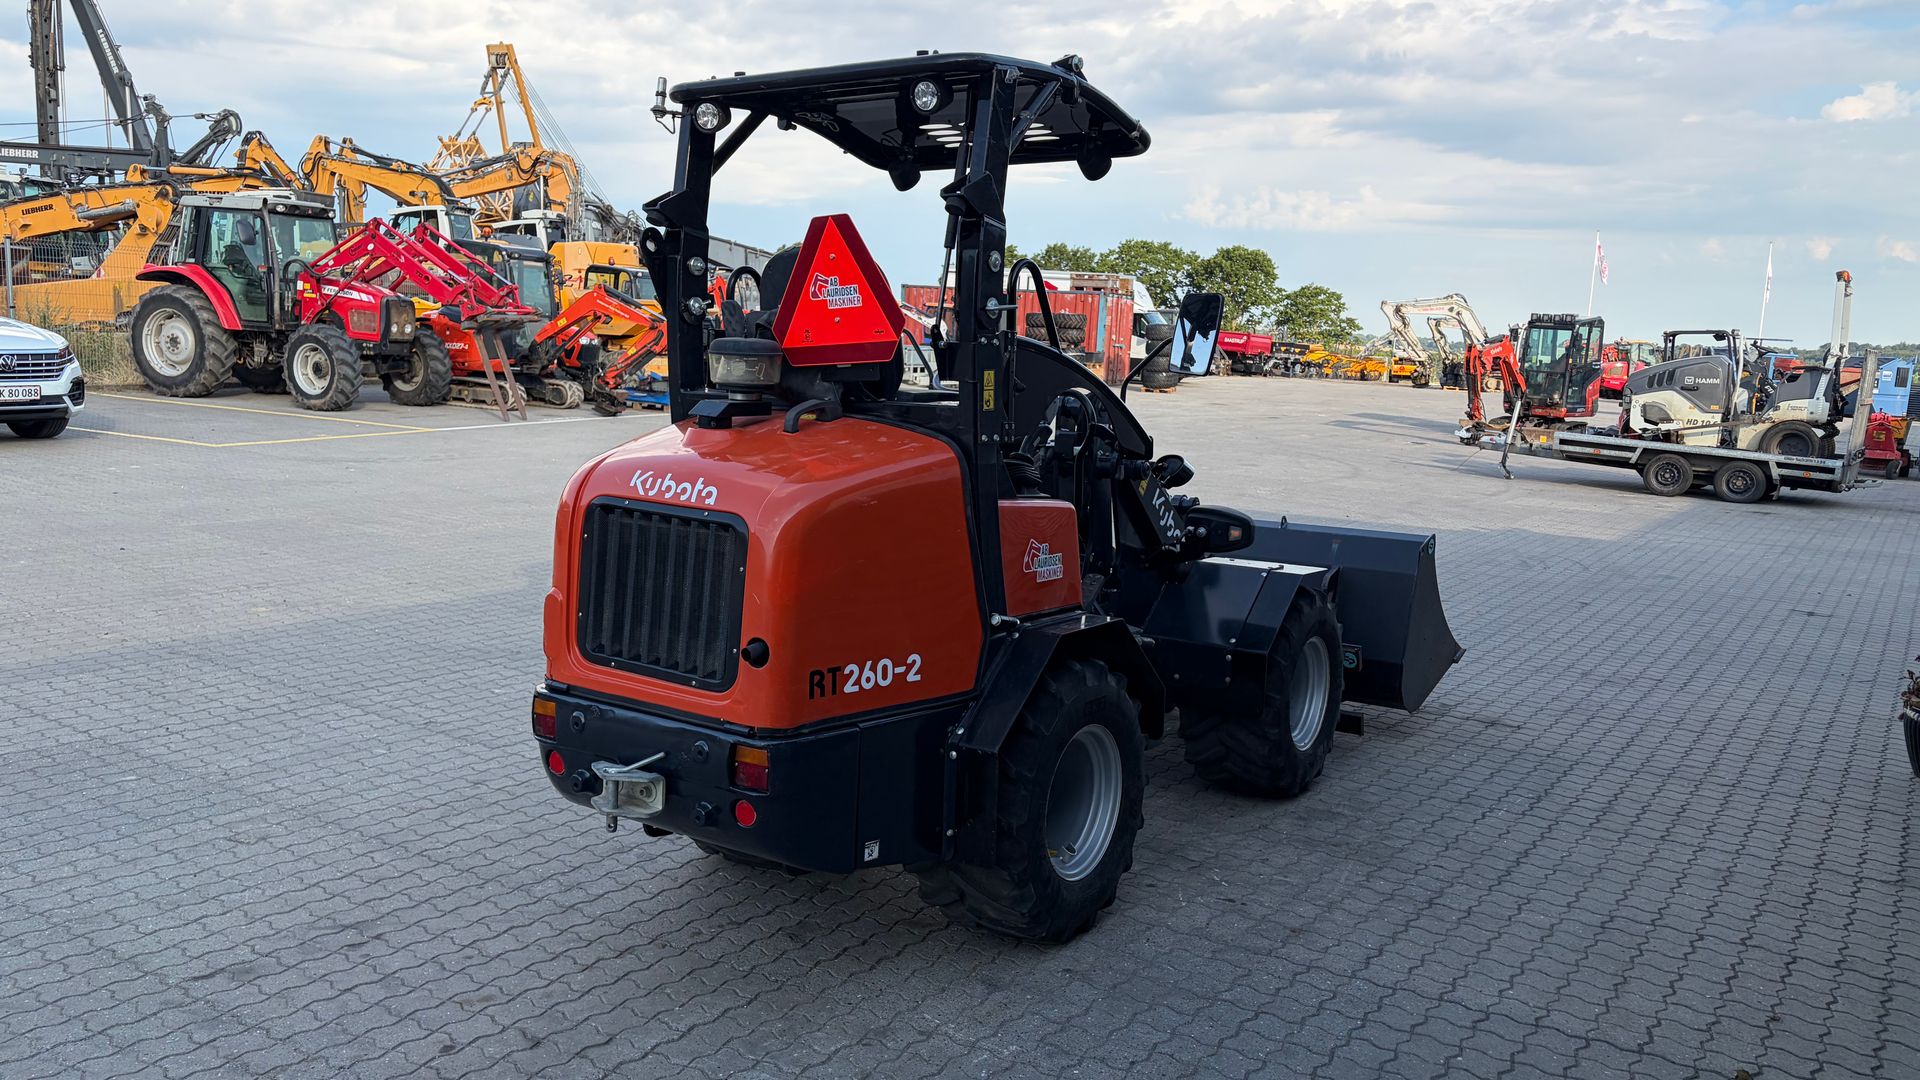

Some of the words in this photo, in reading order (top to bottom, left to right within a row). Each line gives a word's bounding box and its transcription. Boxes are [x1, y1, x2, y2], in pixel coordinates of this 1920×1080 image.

[21, 203, 54, 216] LIEBHERR
[829, 277, 839, 287] AB
[822, 286, 858, 299] LAURIDSEN
[828, 296, 862, 308] MASKINER
[8, 389, 20, 398] 80
[21, 388, 39, 398] 088
[1686, 418, 1699, 426] HD
[630, 470, 718, 505] Kubota
